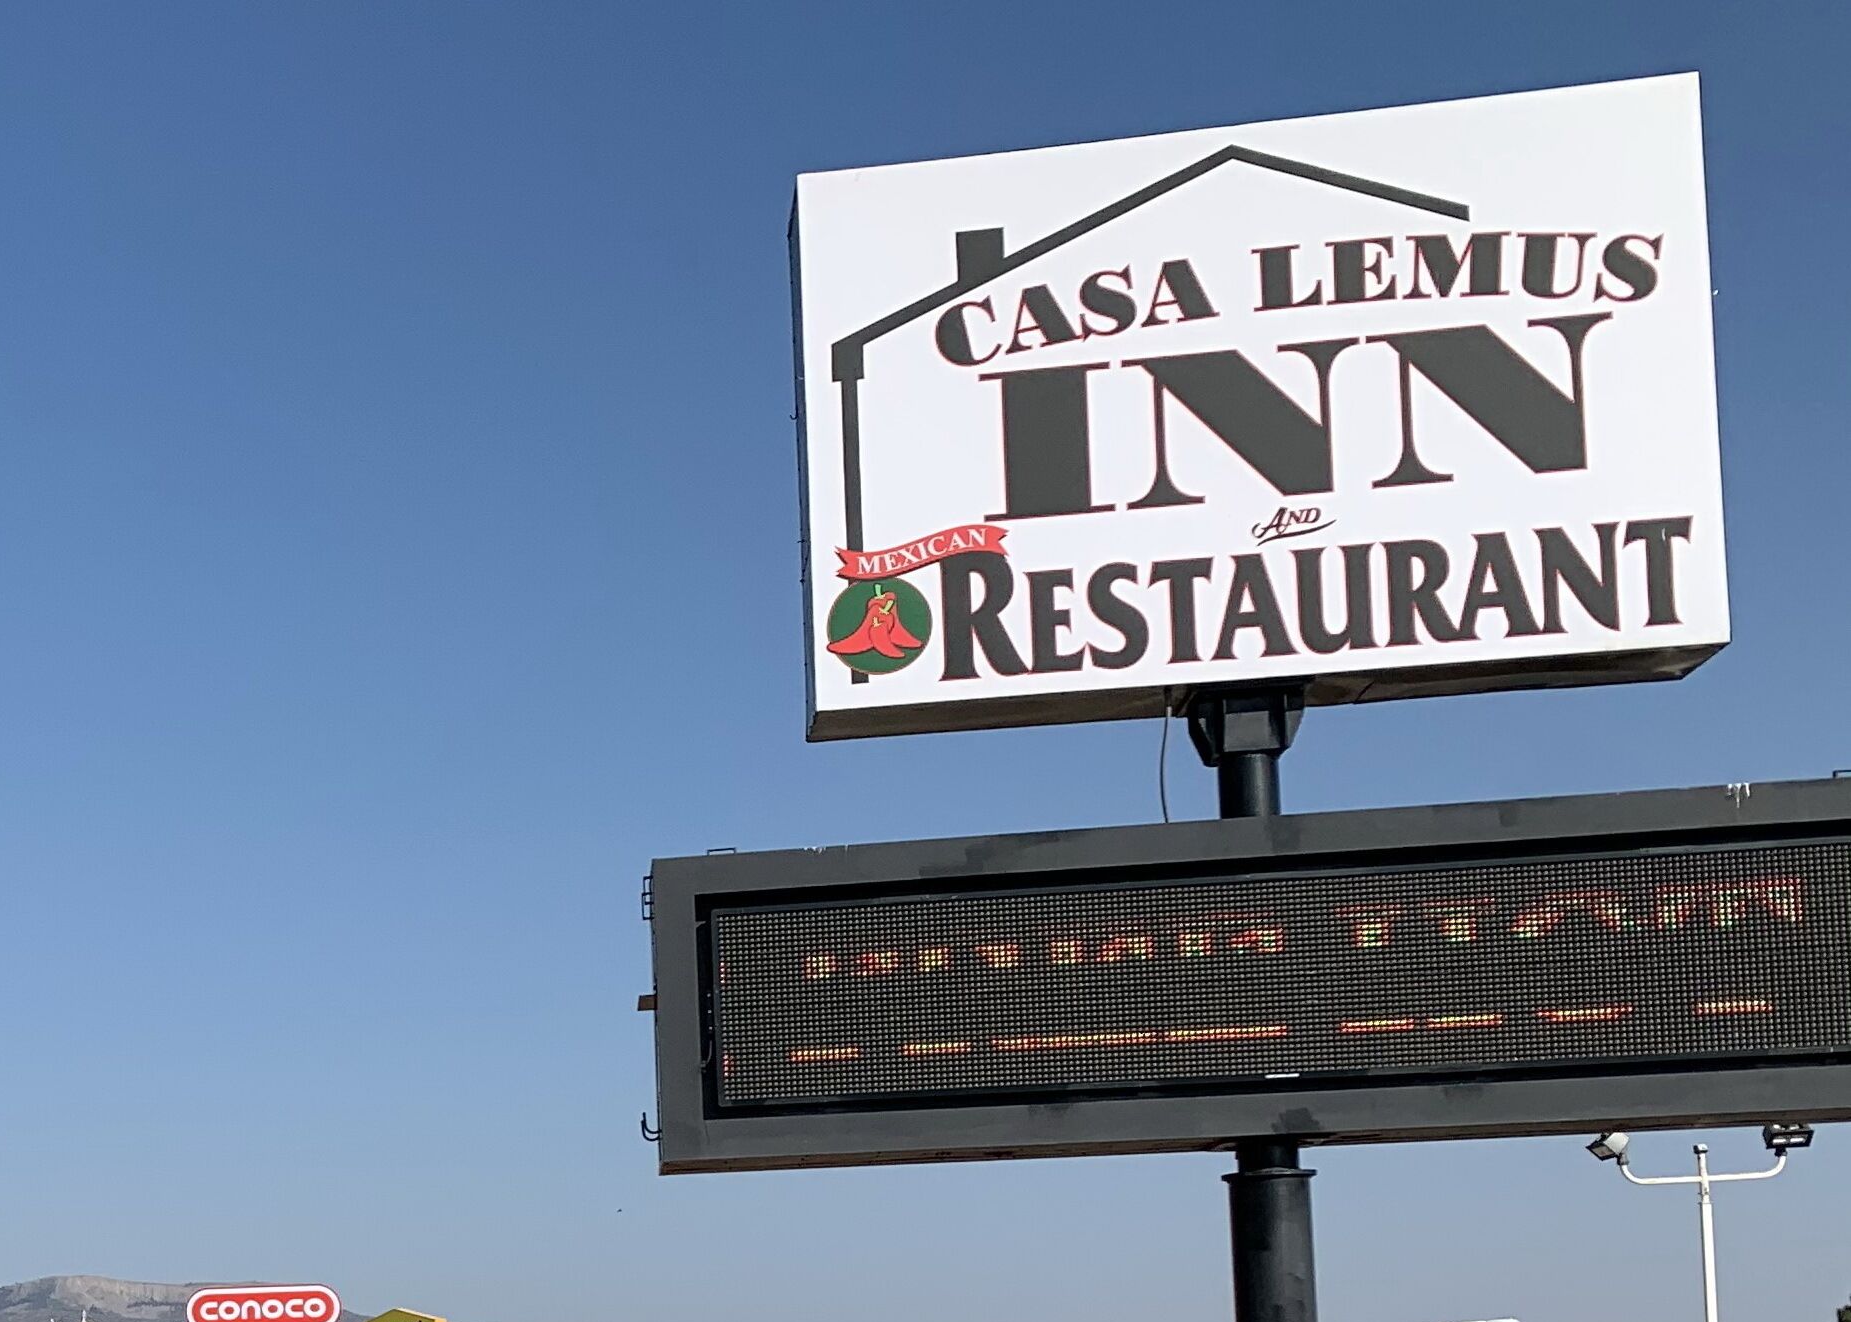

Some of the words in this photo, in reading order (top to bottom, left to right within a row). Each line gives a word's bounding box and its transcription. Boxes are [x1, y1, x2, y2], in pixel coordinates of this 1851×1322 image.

[935, 258, 1220, 366] CASA
[1251, 232, 1663, 312] LEMUS
[978, 311, 1613, 522] INN
[856, 527, 987, 577] MEXICAN
[938, 516, 1693, 682] RESTAURANT
